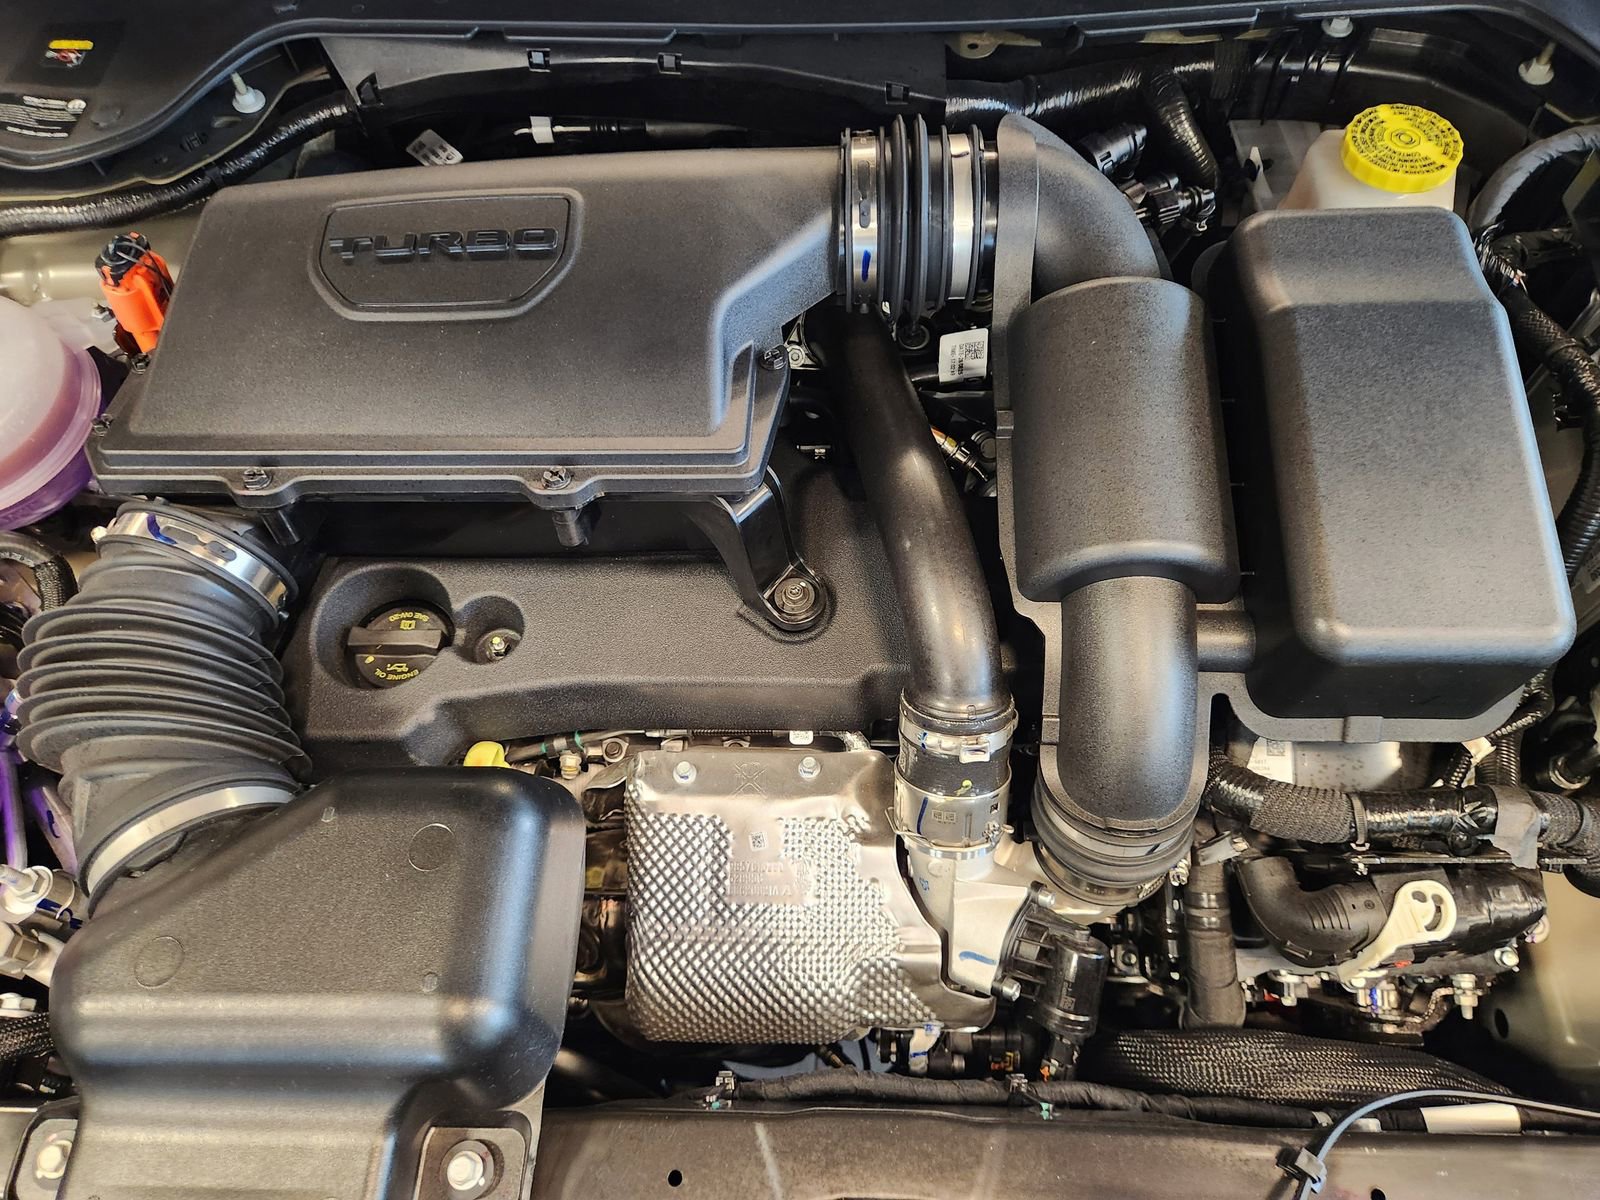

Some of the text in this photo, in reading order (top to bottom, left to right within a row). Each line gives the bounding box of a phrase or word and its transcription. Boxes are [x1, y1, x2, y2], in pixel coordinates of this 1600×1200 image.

[329, 227, 559, 263] TURBO
[413, 611, 430, 622] SAE
[374, 668, 420, 681] ENGINE OIL
